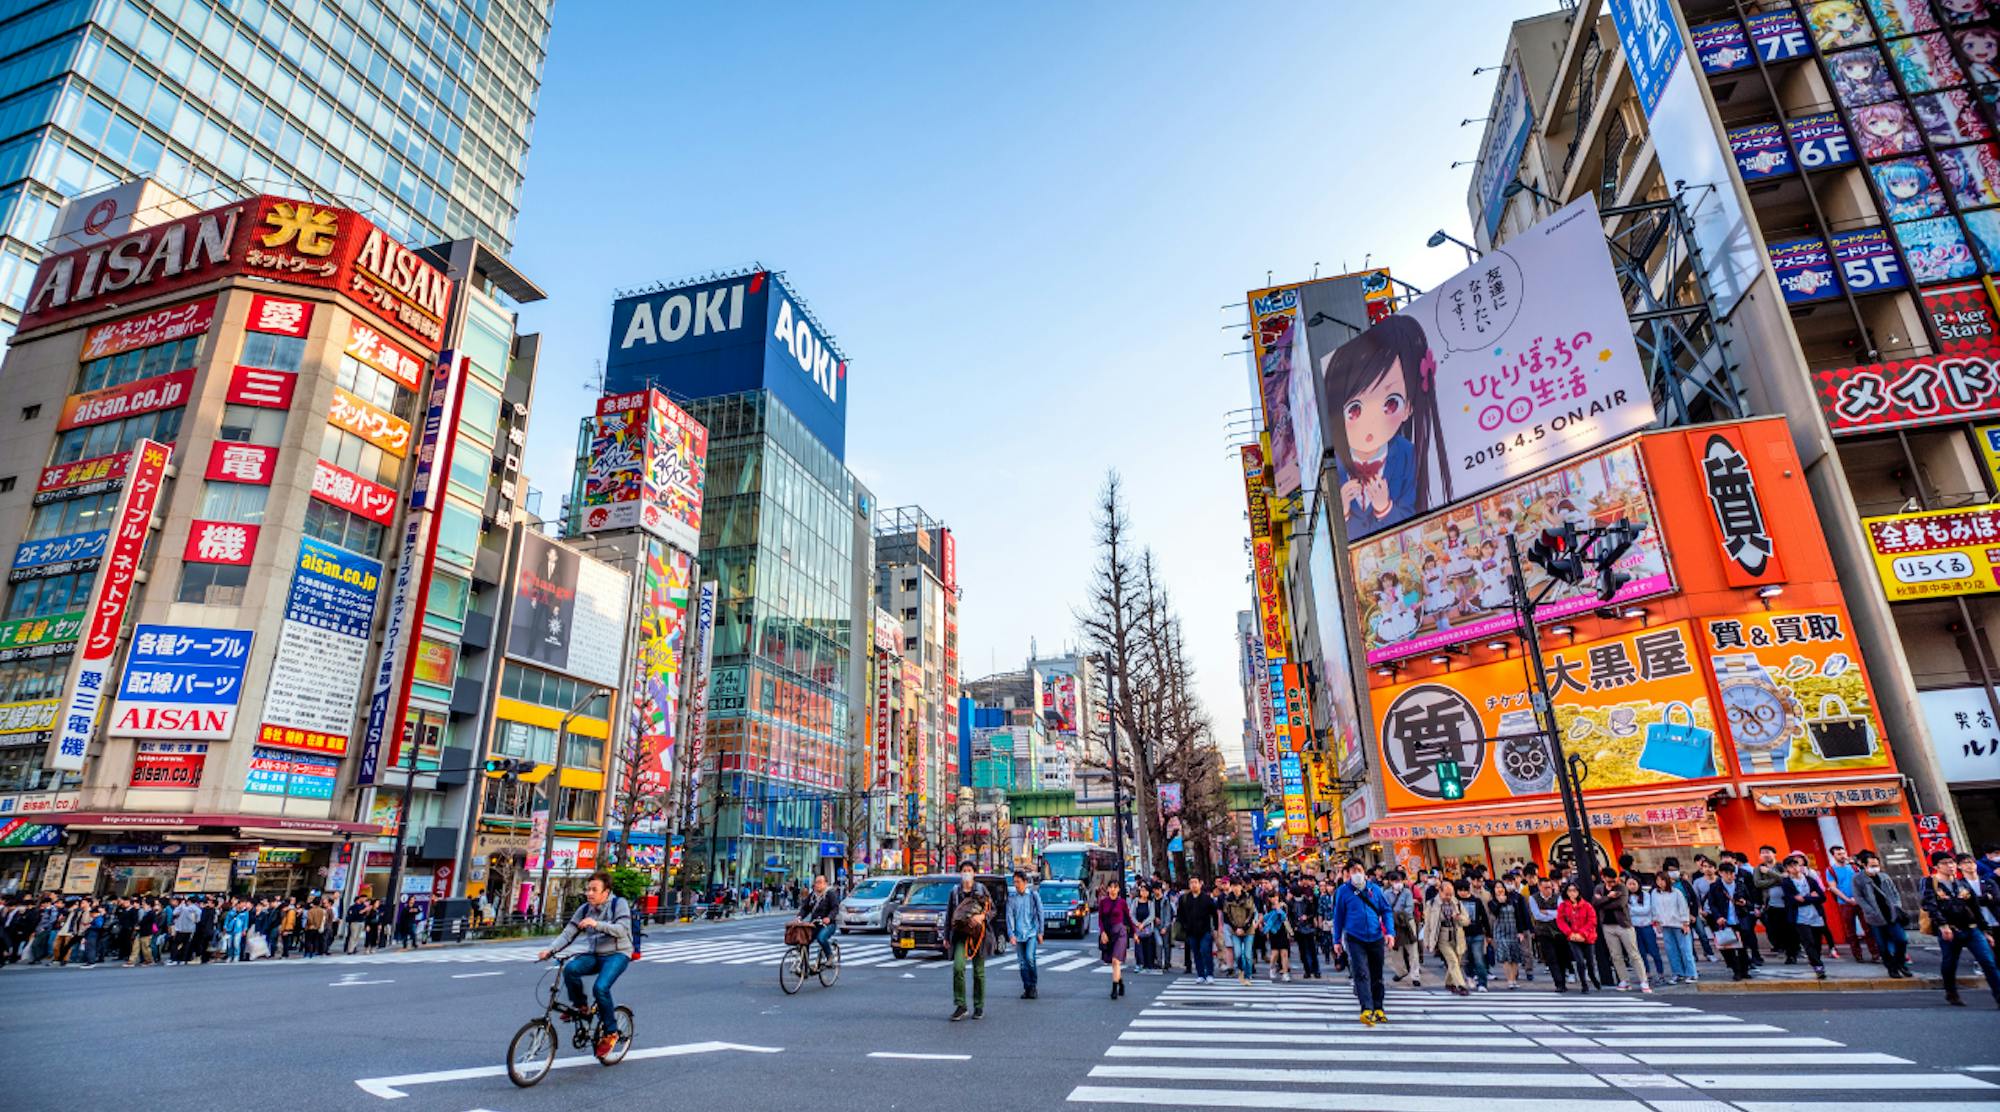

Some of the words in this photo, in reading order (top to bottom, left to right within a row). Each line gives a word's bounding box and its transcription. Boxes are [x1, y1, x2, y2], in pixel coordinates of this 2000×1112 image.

[1695, 33, 1743, 48] アメニティ
[1751, 22, 1802, 36] ードリーム
[1757, 32, 1806, 60] 7F
[1730, 136, 1782, 150] アメニティ
[1791, 124, 1844, 138] ードリーム
[1800, 136, 1849, 166] 6F
[261, 203, 337, 256] 光
[27, 205, 244, 314] AISAN
[246, 250, 337, 276] ネットワーク
[1773, 254, 1827, 268] アメニティ
[1836, 243, 1893, 256] ードリーム
[1844, 255, 1898, 287] 5F
[357, 228, 450, 320] AISAN
[1485, 266, 1507, 310] 友達に
[258, 301, 303, 332] 愛
[621, 284, 745, 349] AOKI
[1469, 280, 1491, 333] なりたい
[1939, 321, 1992, 339] Stars
[347, 327, 420, 385] 光通信
[774, 299, 837, 404] AOKI
[1464, 331, 1592, 399] ひとりぼっちの
[74, 382, 182, 423] aisan.co.jp
[239, 372, 285, 402] 三
[1837, 358, 2000, 422] メイド
[329, 392, 408, 448] ネットワーク
[1464, 424, 1545, 470] 2019.4.5
[1551, 406, 1584, 432] ON
[1590, 389, 1628, 419] AIR
[42, 469, 63, 487] 3F
[222, 446, 266, 480] 電
[312, 466, 394, 517] 配線パーツ
[1703, 454, 1772, 559] 質
[17, 548, 37, 564] 2F
[40, 534, 107, 563] ネットワーク
[91, 449, 164, 649] 光・ケーブル・ネットワーク
[199, 525, 247, 560] 機
[1881, 517, 2000, 549] 全身もみほ
[301, 553, 377, 591] aisan.co.jp
[1900, 558, 1965, 577] りらくる
[701, 587, 714, 629] AKKY
[137, 632, 246, 660] 各種ケーブル
[1710, 621, 1746, 649] 質
[1751, 627, 1770, 646] &
[1772, 614, 1843, 644] 買取
[1545, 628, 1692, 699] 大黒屋
[127, 671, 236, 696] 配線パーツ
[1252, 637, 1268, 668] AKKY
[1264, 732, 1276, 762] Shop
[1486, 690, 1531, 710] チケッ
[61, 670, 102, 757] 愛三電機
[117, 707, 228, 731] AISAN
[1954, 709, 1993, 731] 喫茶
[361, 697, 386, 776] AISAN
[1392, 695, 1481, 790] 質
[133, 764, 204, 784] aisan.co.jp
[1786, 786, 1898, 805] 1階にて高価買取中
[1645, 806, 1705, 823] 無料査定
